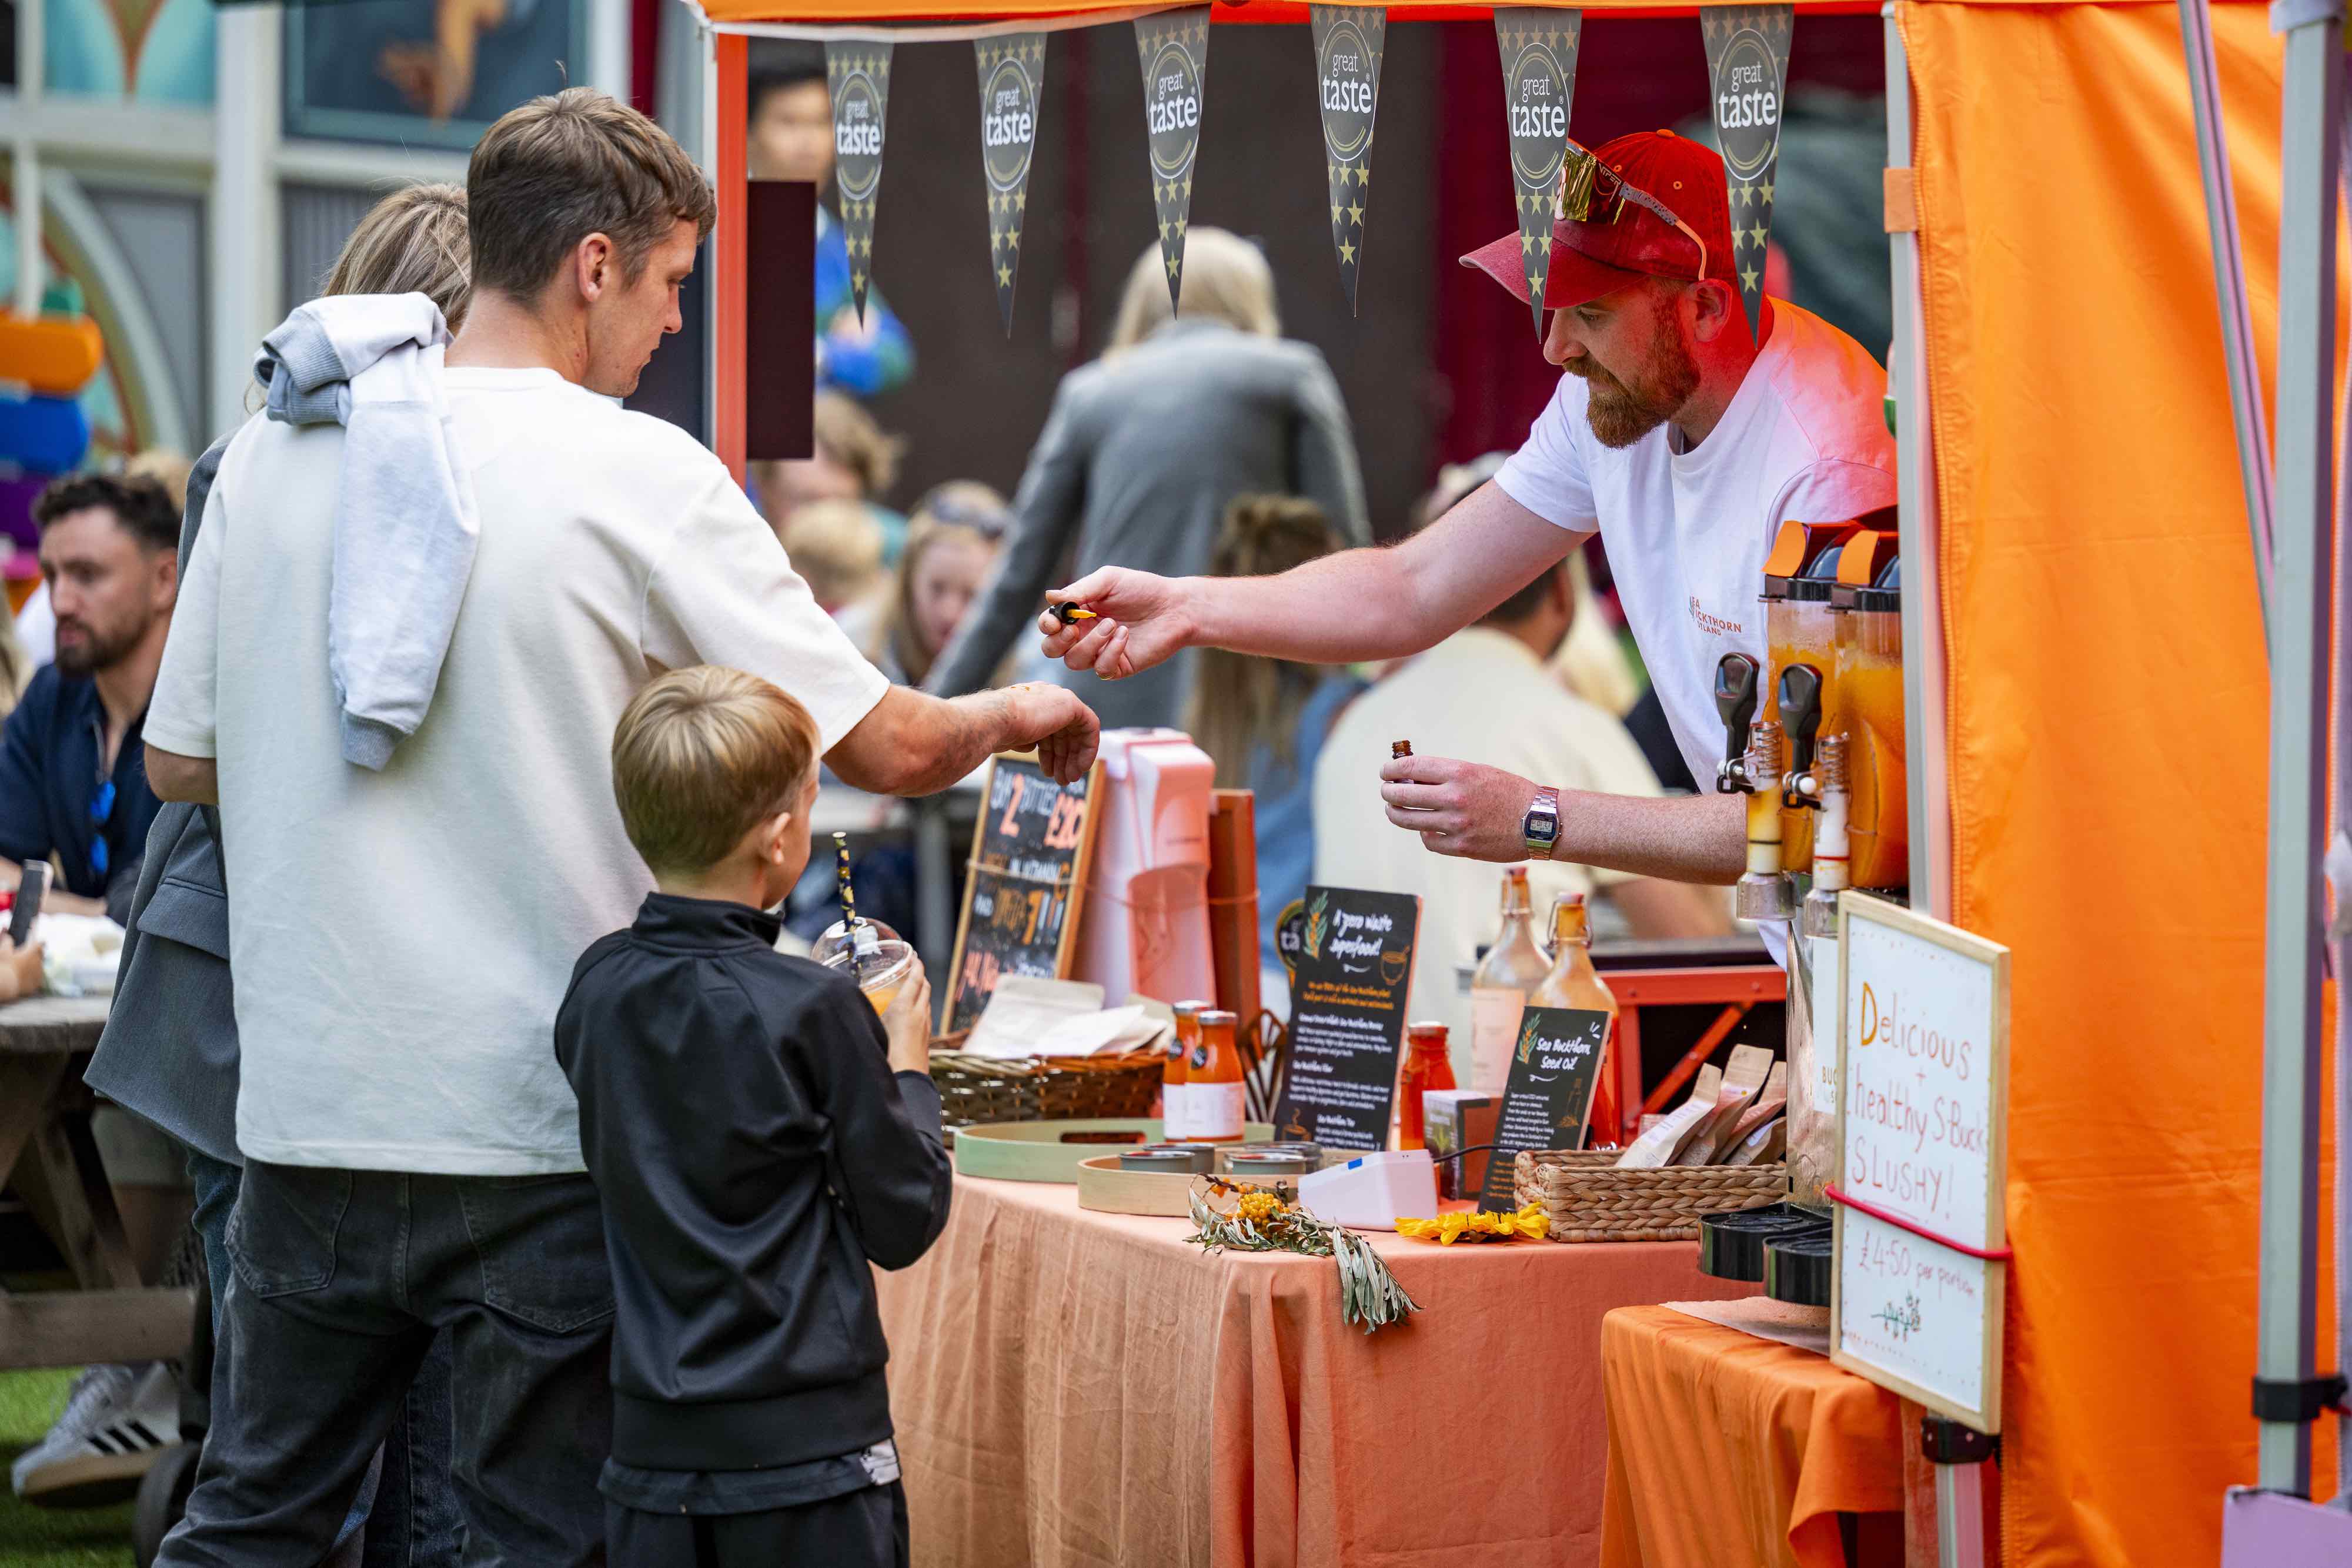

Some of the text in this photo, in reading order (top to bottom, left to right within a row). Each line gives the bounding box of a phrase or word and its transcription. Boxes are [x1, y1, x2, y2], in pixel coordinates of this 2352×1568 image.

[1332, 53, 1358, 77] great
[1732, 62, 1762, 91] great
[995, 88, 1020, 115] great
[1158, 70, 1183, 101] great
[1322, 75, 1371, 113] taste
[1522, 76, 1549, 102] great
[845, 99, 868, 125] great
[1150, 95, 1198, 135] taste
[1512, 101, 1565, 138] taste
[1719, 88, 1776, 129] taste
[837, 122, 881, 155] taste
[986, 110, 1031, 147] taste
[1000, 772, 1025, 838] 2
[1536, 1036, 1591, 1055] Sea Buckthorn
[1861, 981, 1971, 1081] Delicious
[1540, 1055, 1578, 1071] Seed Oil
[1855, 1063, 1927, 1152] healthy
[1853, 1135, 1953, 1221] SLUSHY!
[1916, 1262, 1933, 1289] per
